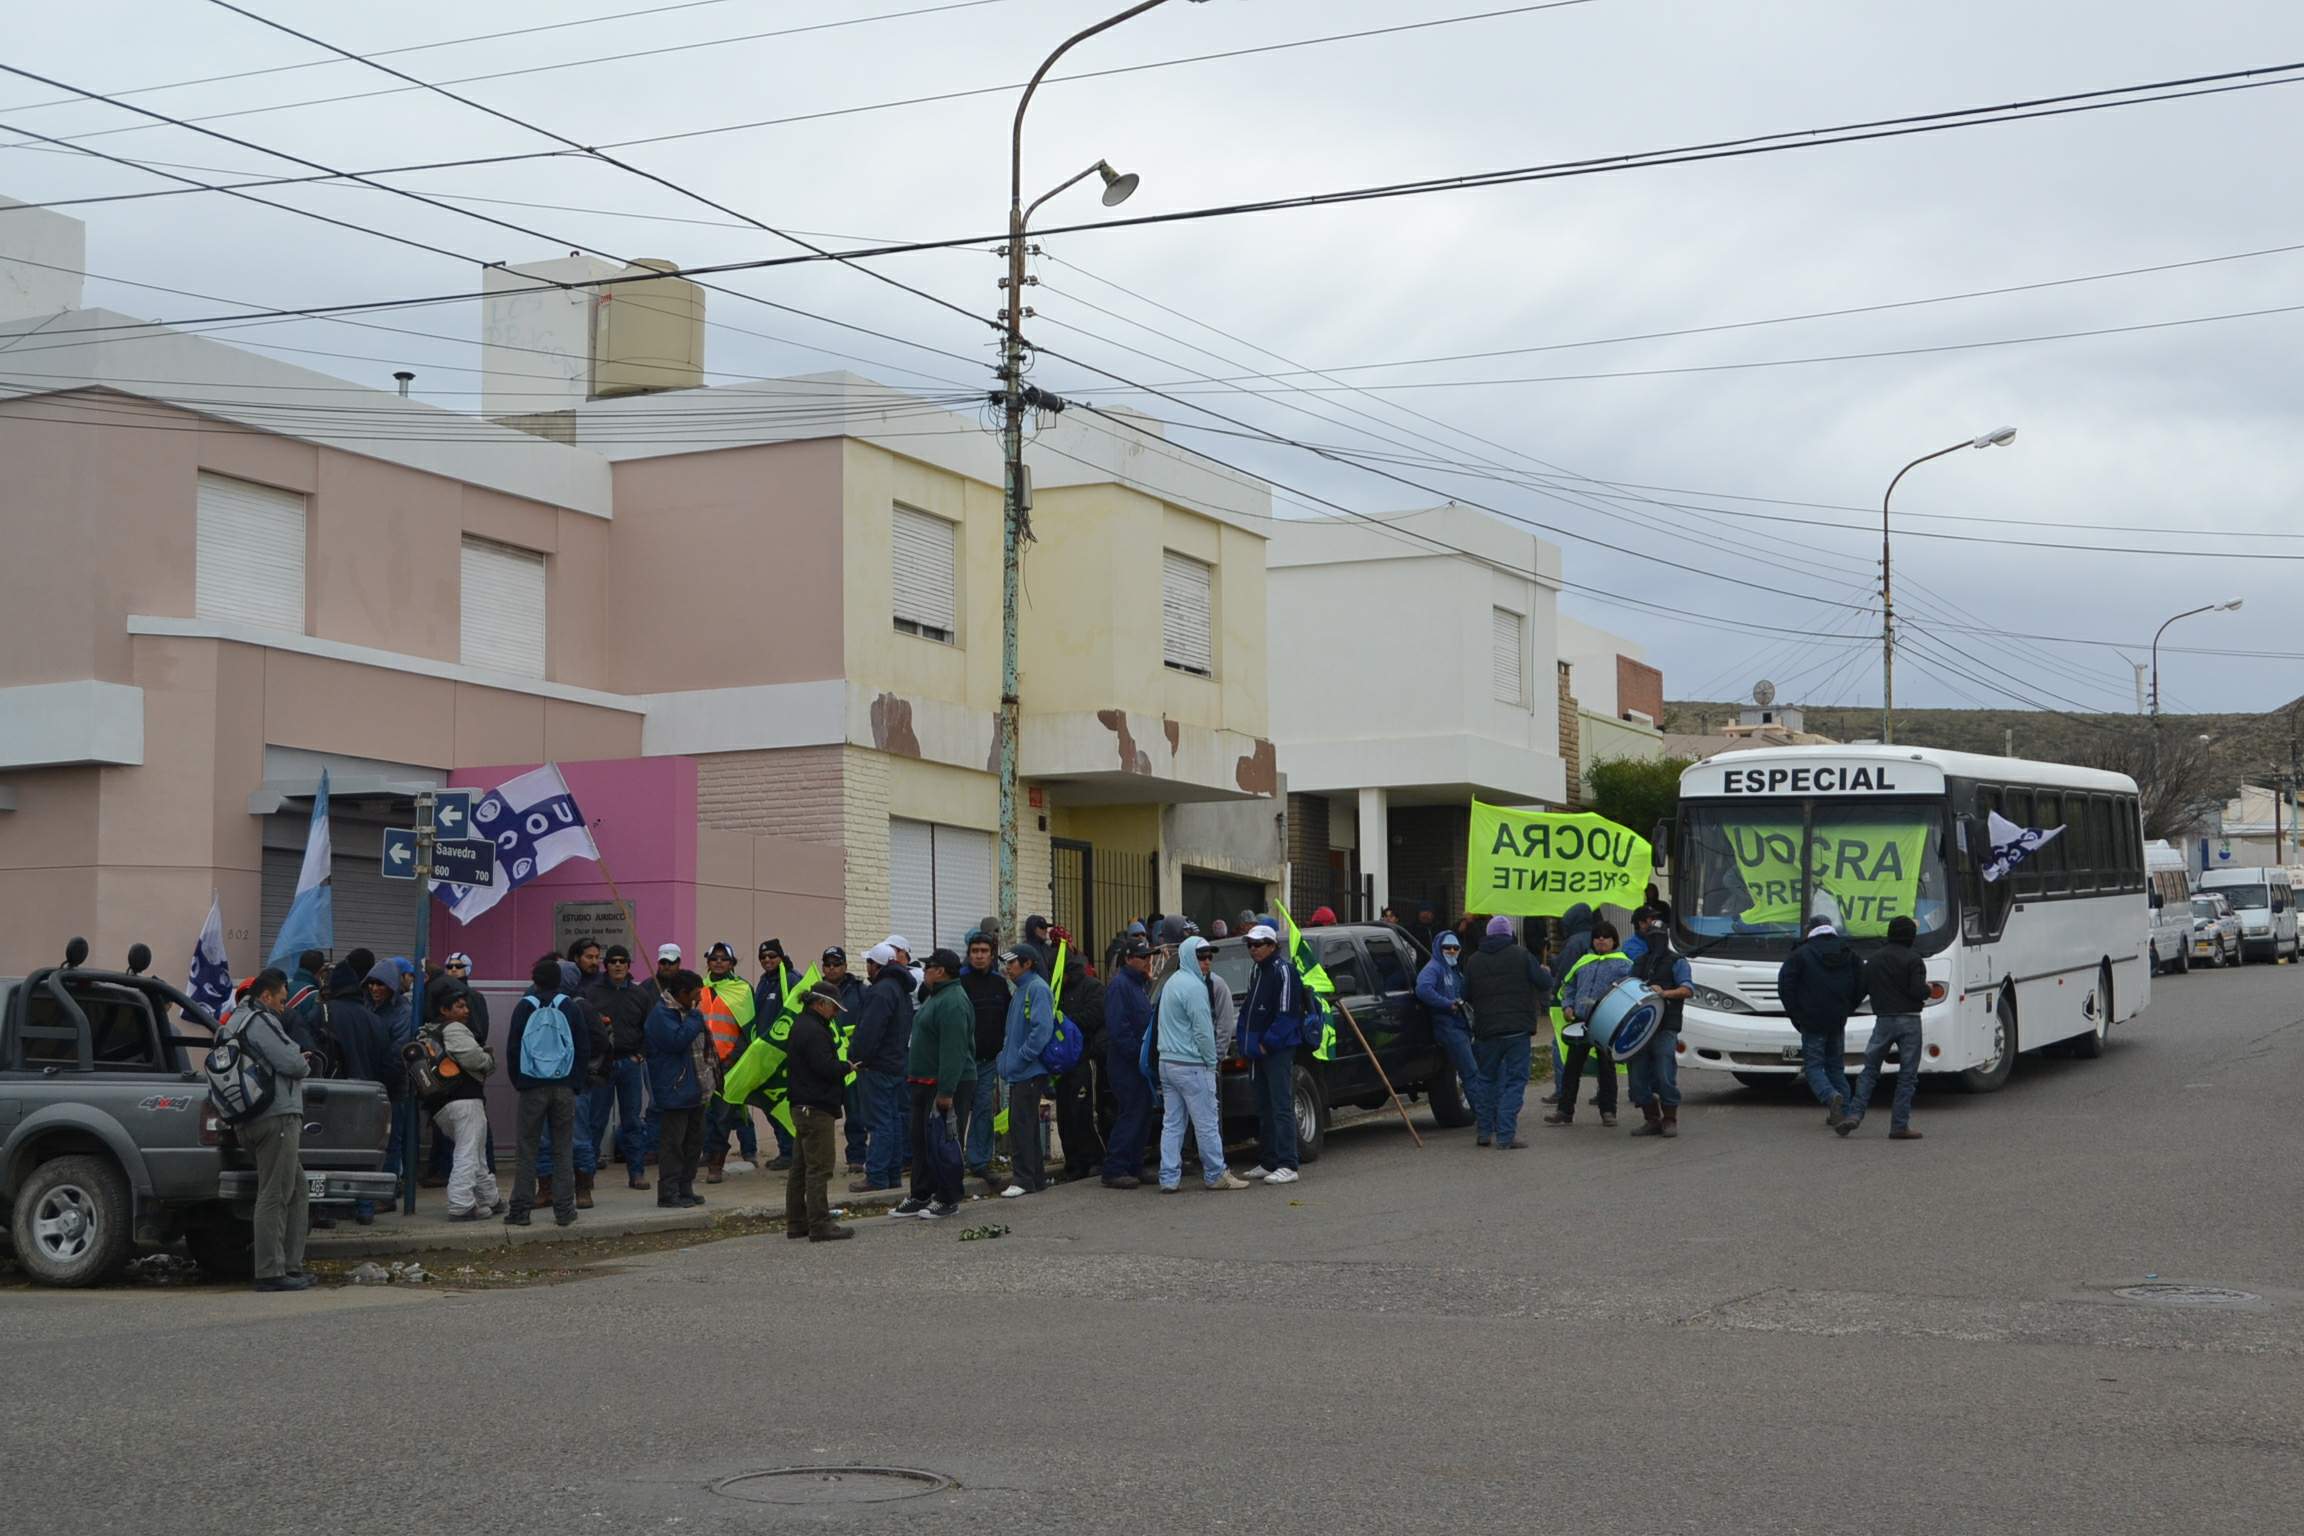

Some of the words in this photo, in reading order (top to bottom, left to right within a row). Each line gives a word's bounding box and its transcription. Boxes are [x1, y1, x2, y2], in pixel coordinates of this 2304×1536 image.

[1723, 766, 1896, 794] ESPECIAL
[436, 842, 477, 860] Saavedra
[434, 865, 450, 877] 600
[474, 870, 490, 882] 700
[562, 912, 592, 922] ESTUDIO
